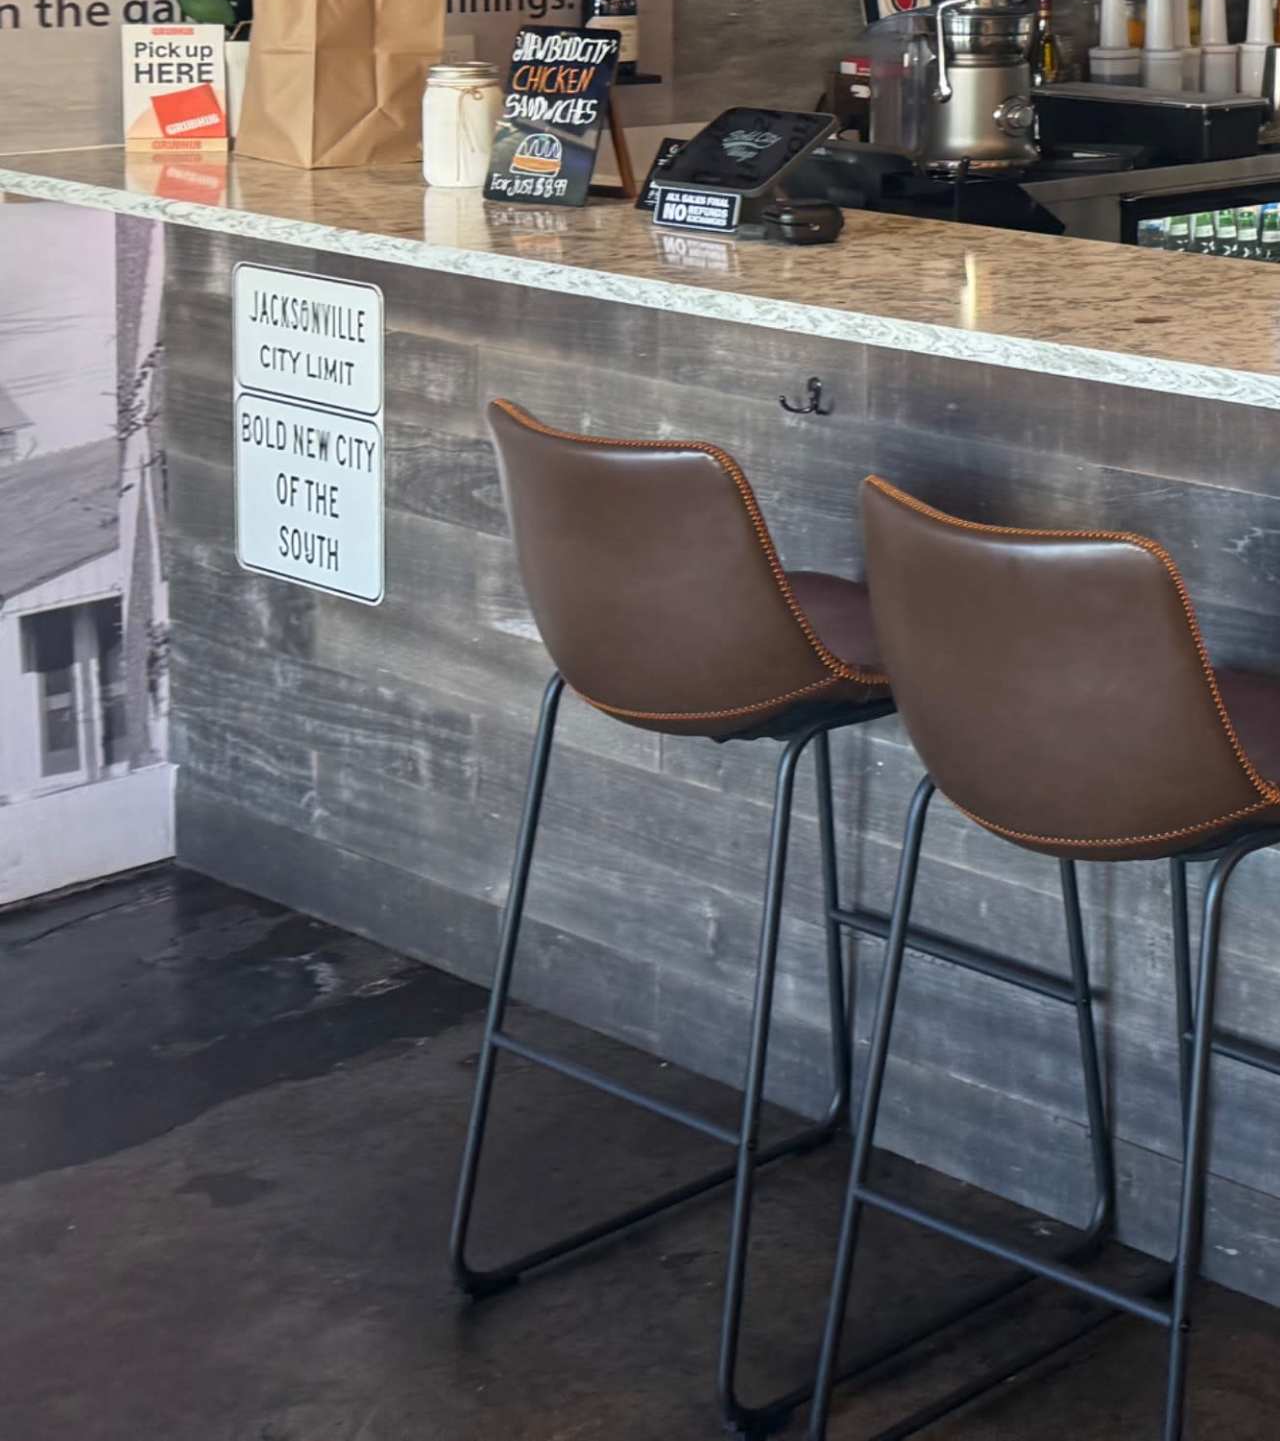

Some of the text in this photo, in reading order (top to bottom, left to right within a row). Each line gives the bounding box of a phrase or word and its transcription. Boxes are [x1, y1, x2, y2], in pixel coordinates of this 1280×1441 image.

[134, 42, 213, 60] Pick up
[134, 62, 214, 83] HERE
[512, 64, 596, 94] CHICKEN
[503, 93, 598, 125] SANDWICHES
[662, 202, 687, 222] NO
[249, 289, 366, 344] JACKSONVILLE
[260, 345, 355, 386] CITY LIMIT
[241, 412, 376, 473] BOLD NEW CITY
[277, 472, 340, 519] OF THE
[279, 525, 340, 572] SOUTH
